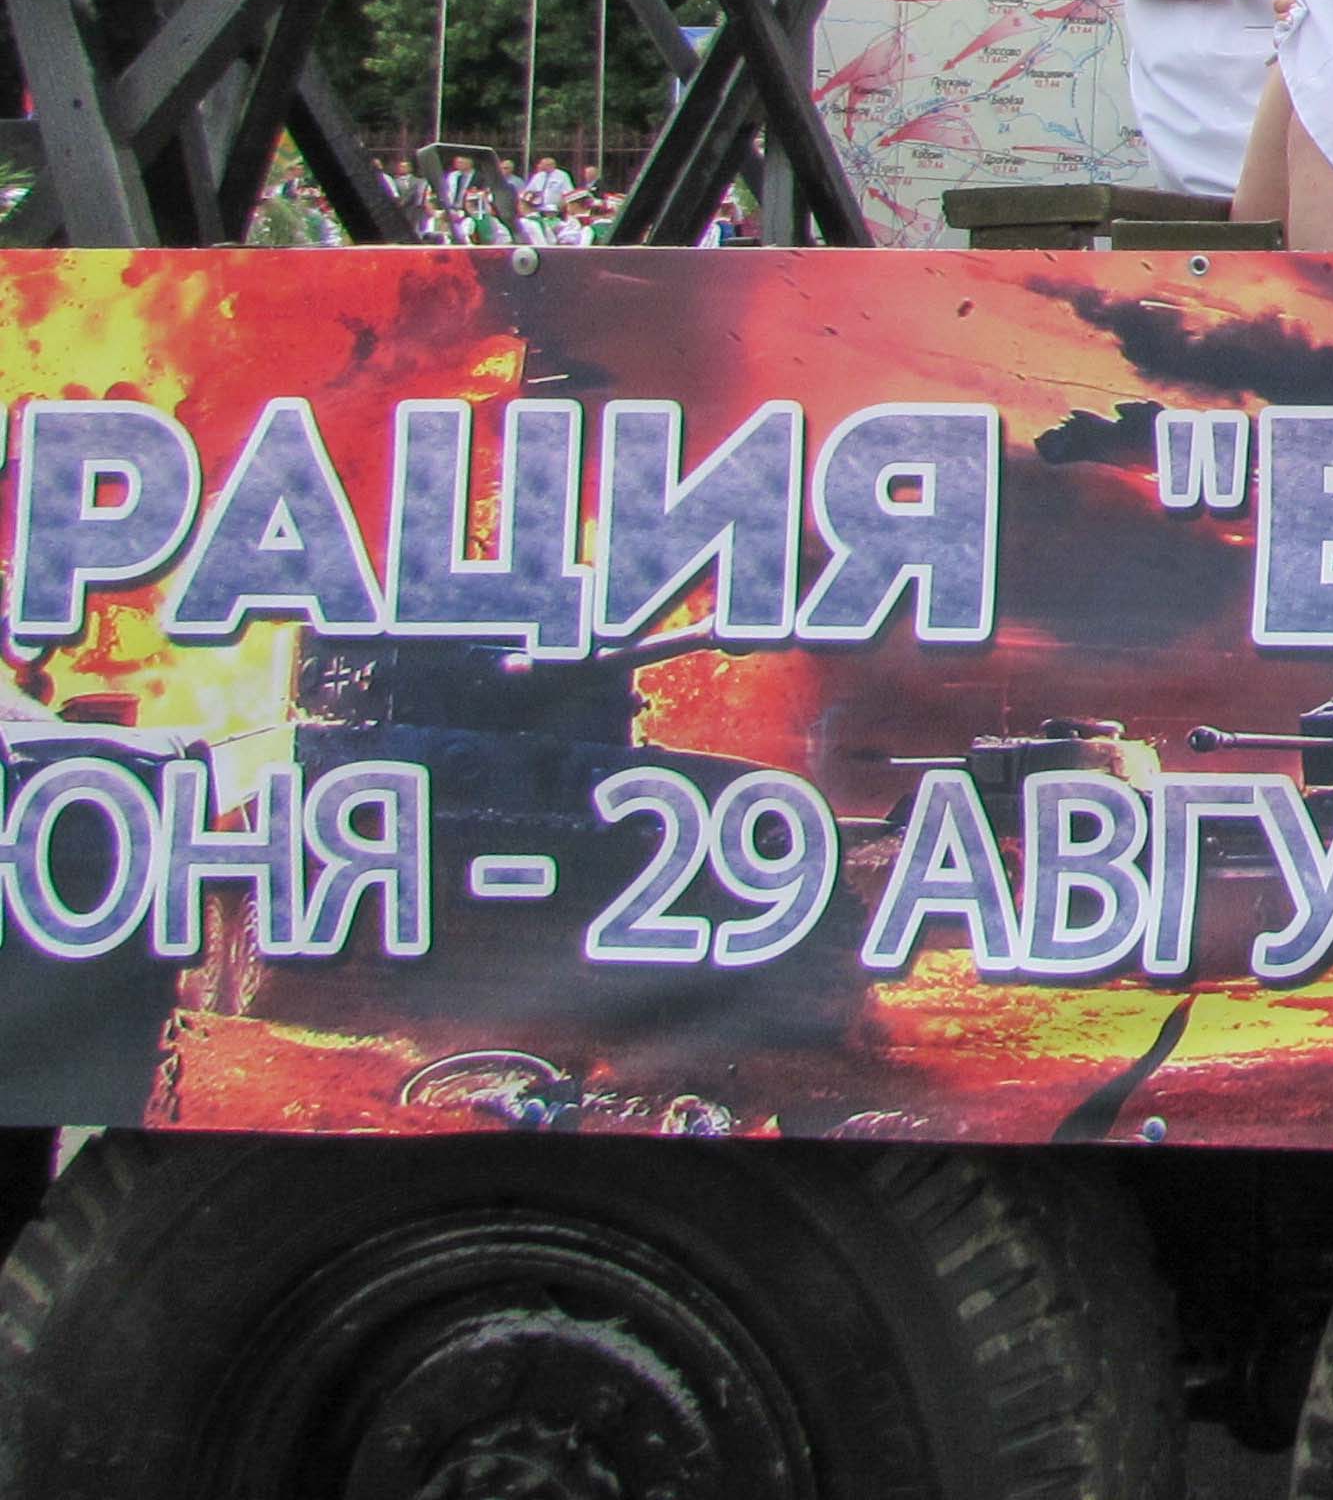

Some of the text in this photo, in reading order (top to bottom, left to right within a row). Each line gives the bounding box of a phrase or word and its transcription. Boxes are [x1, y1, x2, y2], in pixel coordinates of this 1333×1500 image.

[0, 398, 1000, 661] РАЦИЯ
[469, 855, 557, 897] -
[586, 765, 839, 967] 29
